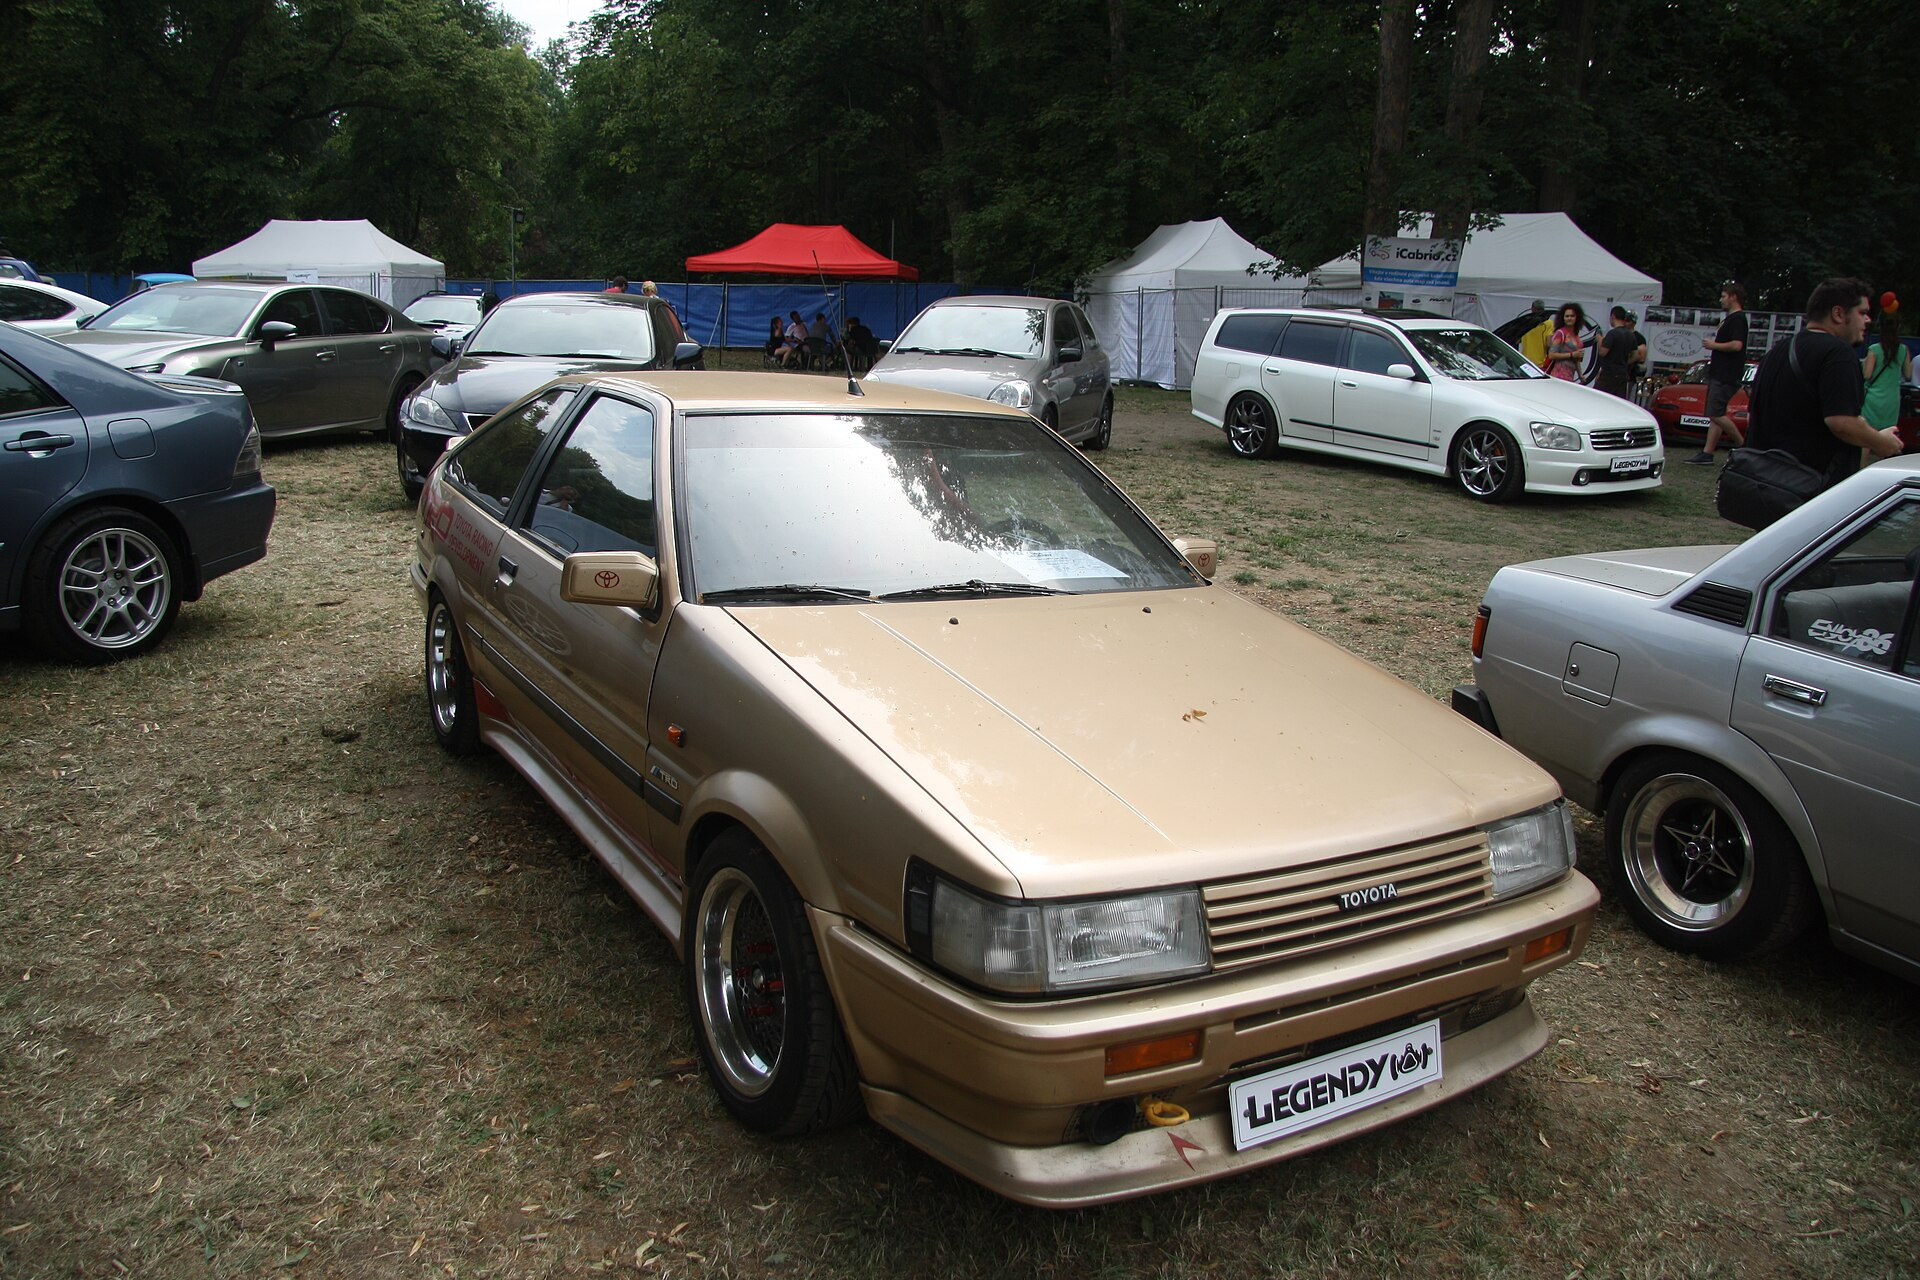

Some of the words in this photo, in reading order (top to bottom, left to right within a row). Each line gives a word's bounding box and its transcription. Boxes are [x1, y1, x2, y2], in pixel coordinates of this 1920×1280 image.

[448, 534, 485, 574] DEVELOPMENT
[454, 512, 473, 538] TOYOTA
[473, 529, 494, 557] RACING
[1340, 883, 1398, 908] TOYOTA
[1246, 1053, 1389, 1130] LEGENDY
